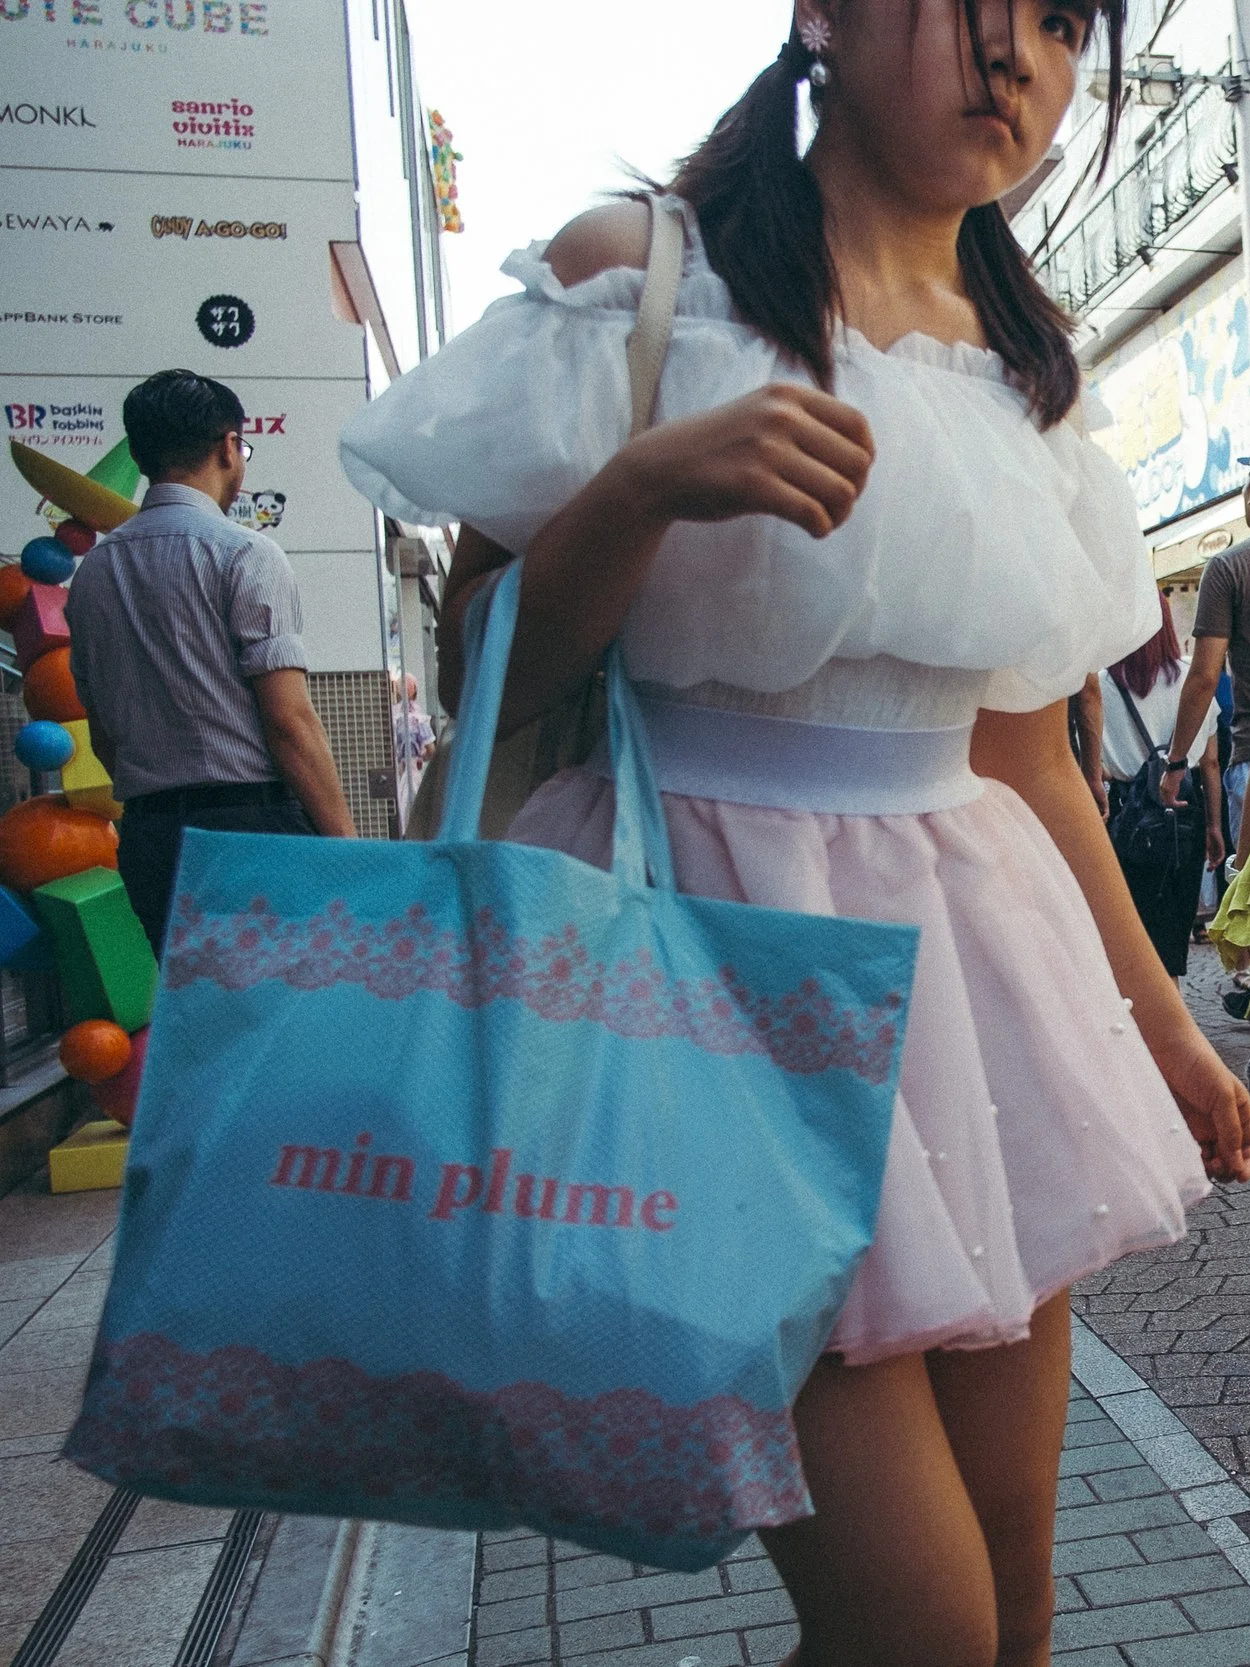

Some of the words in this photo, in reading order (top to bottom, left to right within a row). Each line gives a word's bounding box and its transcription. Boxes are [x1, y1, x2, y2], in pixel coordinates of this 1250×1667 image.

[125, 0, 269, 36] CUBE
[66, 38, 168, 54] HARAJUKU
[171, 98, 254, 117] sanrio
[172, 116, 255, 137] vivitix
[177, 138, 252, 150] HARAJUKU
[0, 213, 91, 232] EWAYA
[268, 1131, 417, 1202] min
[427, 1146, 681, 1233] plume
